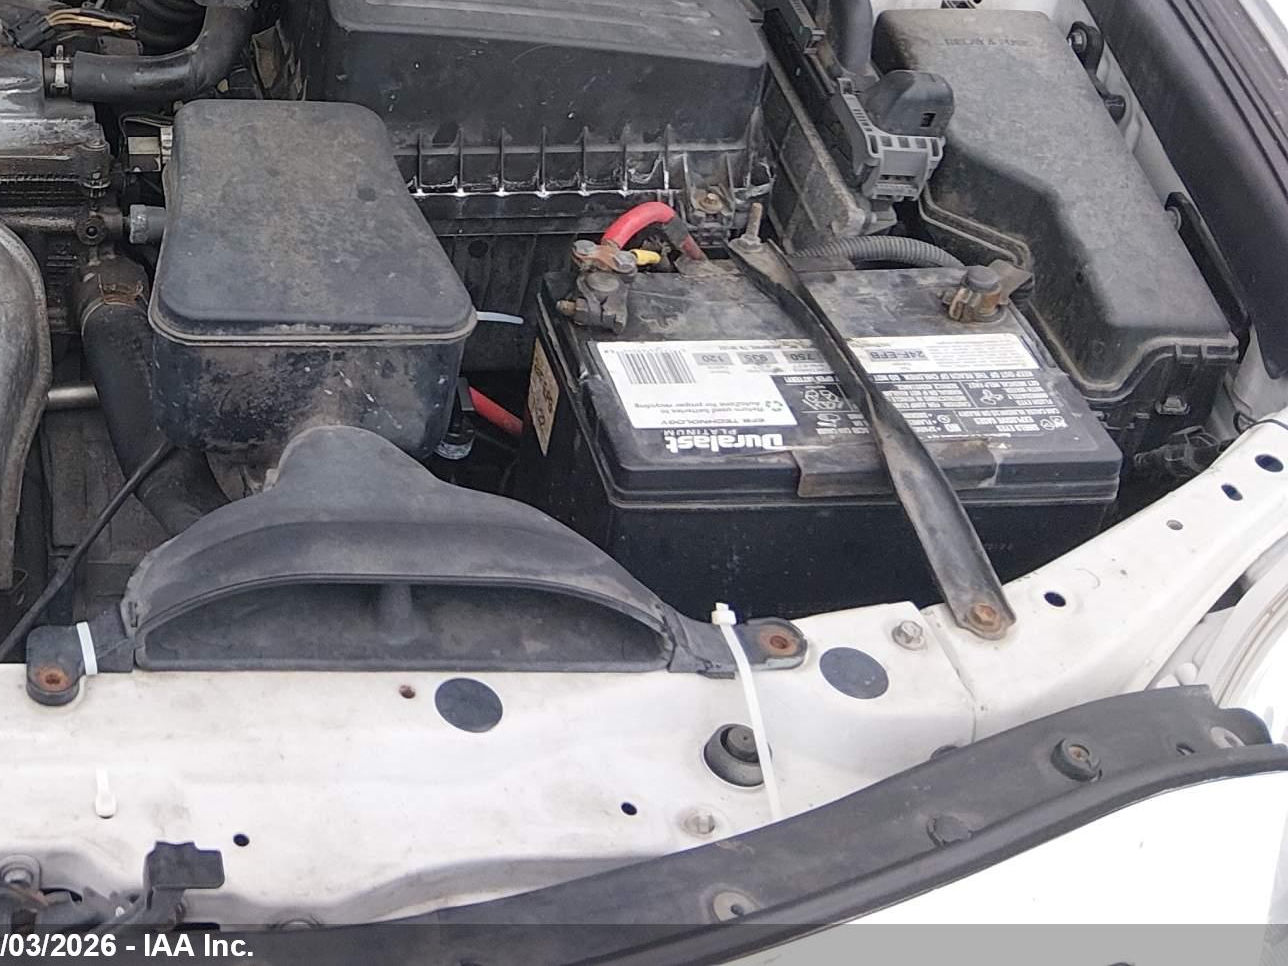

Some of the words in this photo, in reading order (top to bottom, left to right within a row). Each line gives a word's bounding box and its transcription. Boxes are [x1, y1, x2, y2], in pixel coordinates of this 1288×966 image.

[702, 354, 724, 363] 120
[744, 353, 768, 363] 935
[790, 352, 815, 362] 750
[870, 350, 924, 360] 24F-EFB
[664, 433, 783, 454] Duralast
